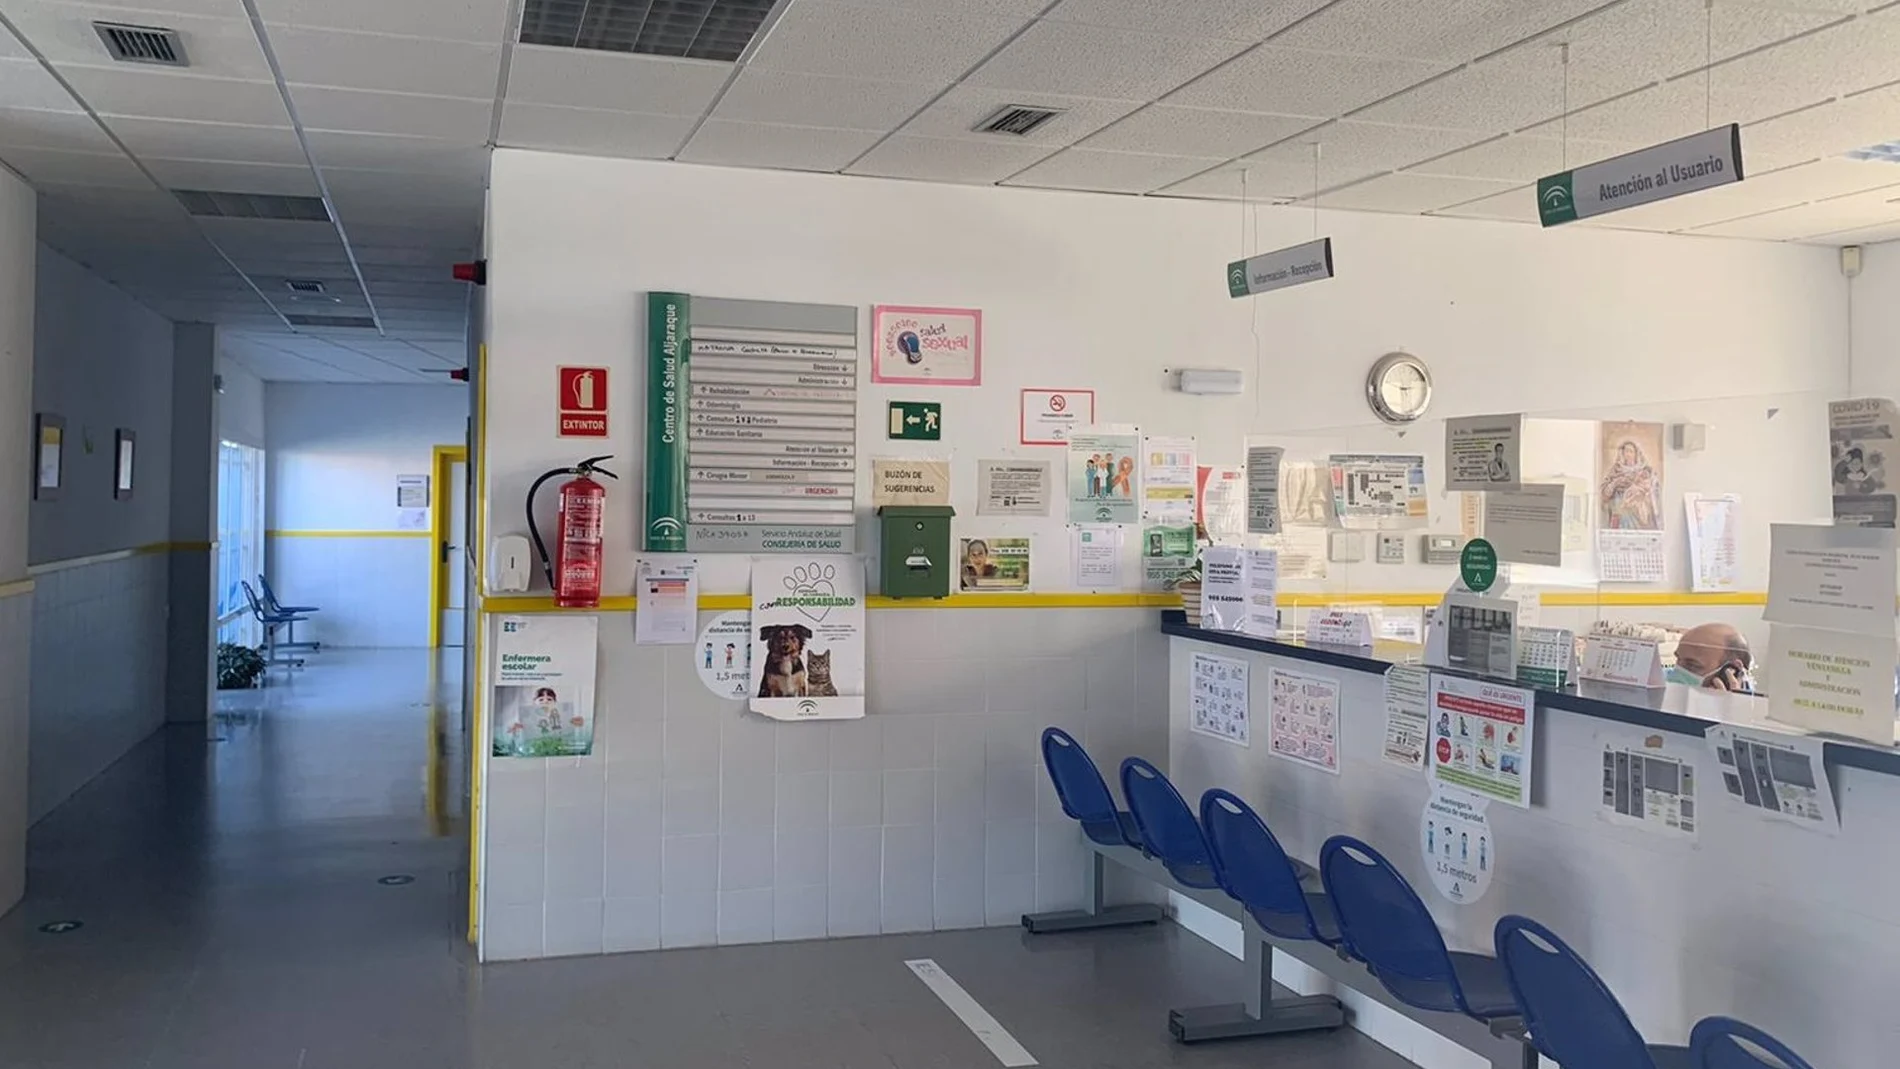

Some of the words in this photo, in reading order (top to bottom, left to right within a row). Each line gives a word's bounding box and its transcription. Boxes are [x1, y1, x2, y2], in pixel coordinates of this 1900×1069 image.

[1600, 174, 1653, 201] Atención
[1656, 168, 1668, 187] al
[1671, 155, 1724, 183] Usuario
[664, 304, 678, 357] Aljaraque
[922, 335, 969, 350] sexual
[663, 358, 675, 389] Salud
[709, 387, 750, 395] Rehabilitación
[663, 391, 675, 405] de
[563, 420, 605, 430] EXTINTOR
[662, 407, 674, 443] Centro
[885, 470, 911, 479] BUZÓN
[912, 471, 923, 479] DE
[884, 485, 936, 493] SUGERENCIAS
[761, 529, 789, 538] Servicio
[790, 529, 814, 538] Andaluz
[814, 530, 823, 538] de
[824, 530, 841, 538] Salud
[807, 540, 817, 549] DE
[818, 541, 842, 549] SALUD
[775, 597, 856, 607] RESPONSABILIDAD
[502, 654, 552, 662] Enfermera
[1788, 650, 1821, 662] HORARIO
[1822, 654, 1833, 663] DE
[502, 662, 537, 671] escolar
[716, 672, 730, 682] 1,5
[1459, 810, 1485, 823] seguridad
[1436, 861, 1449, 874] 1,5
[1449, 867, 1477, 884] metros
